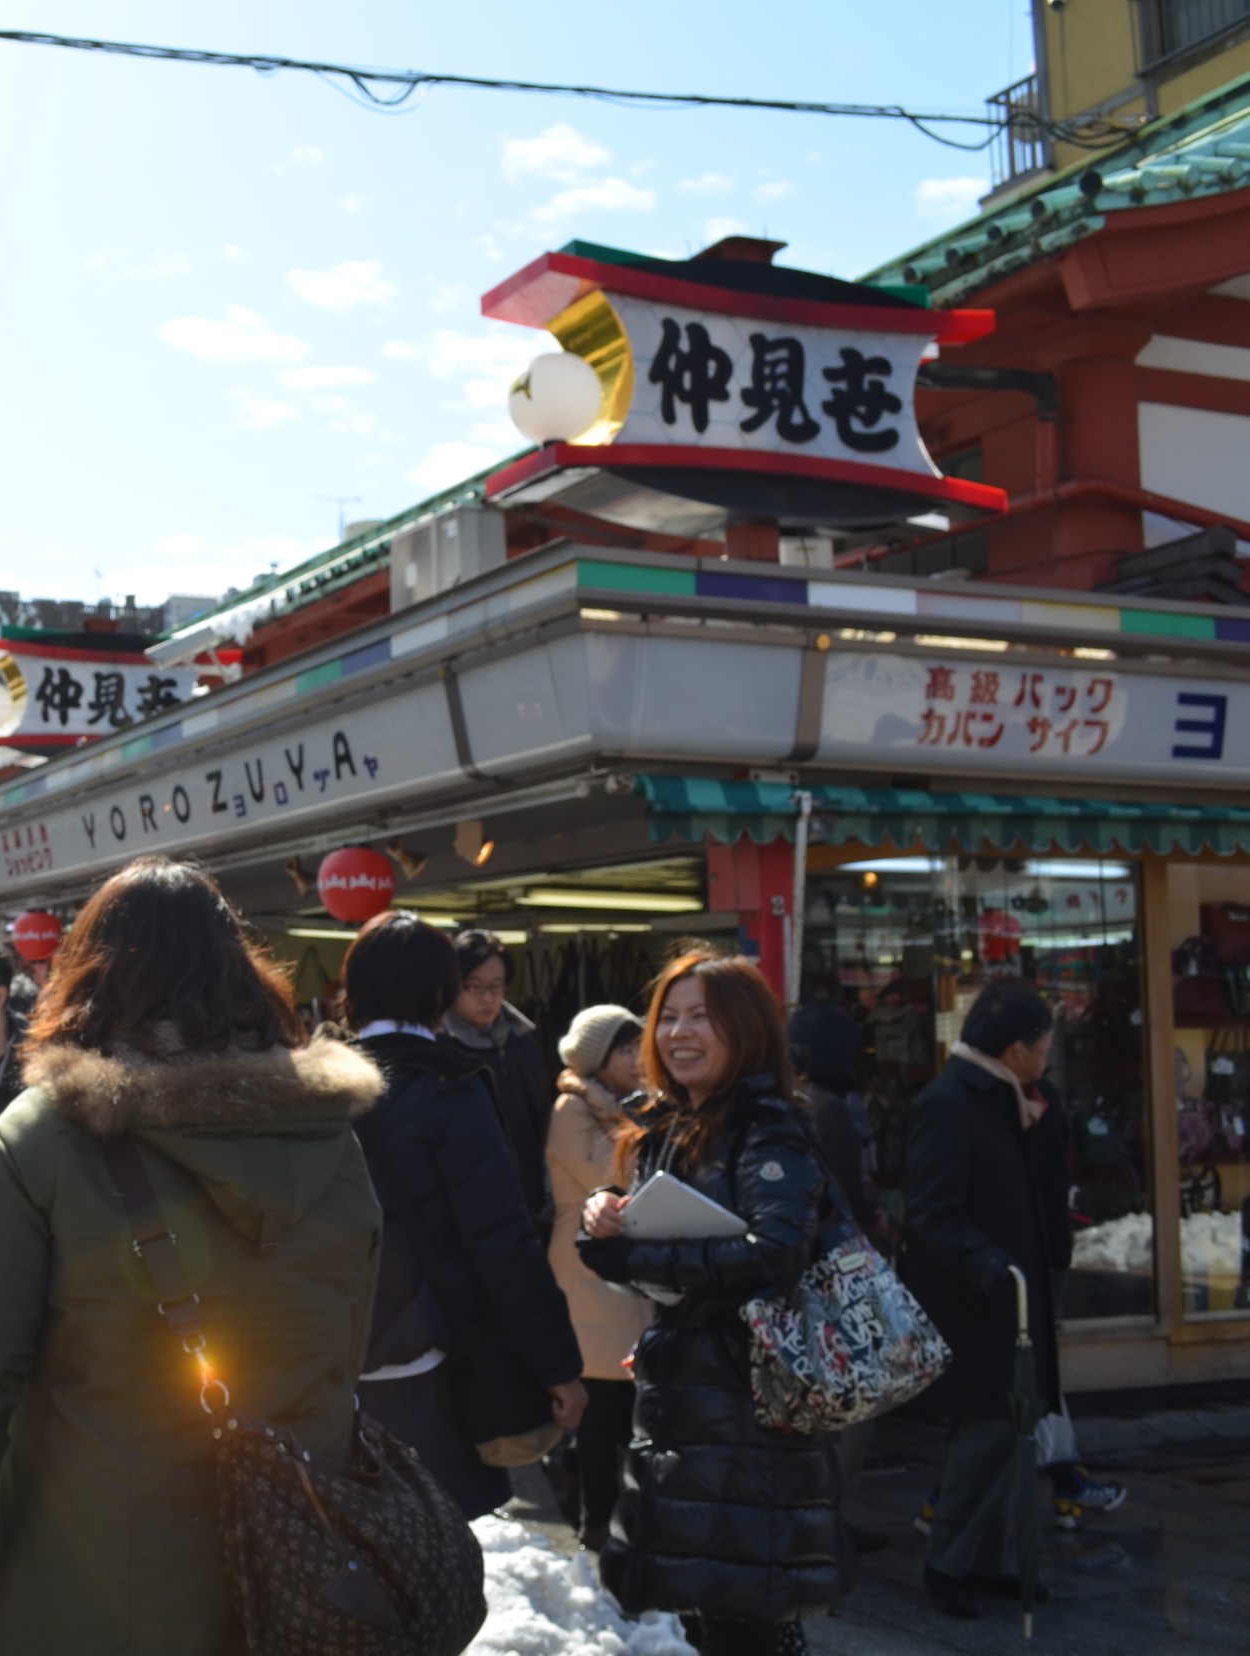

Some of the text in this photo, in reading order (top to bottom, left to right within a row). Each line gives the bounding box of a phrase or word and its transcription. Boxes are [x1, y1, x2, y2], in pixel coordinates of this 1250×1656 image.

[917, 709, 1109, 756] カバン サイフ
[1171, 692, 1228, 760] ヨ
[82, 731, 357, 849] YOROZUYA
